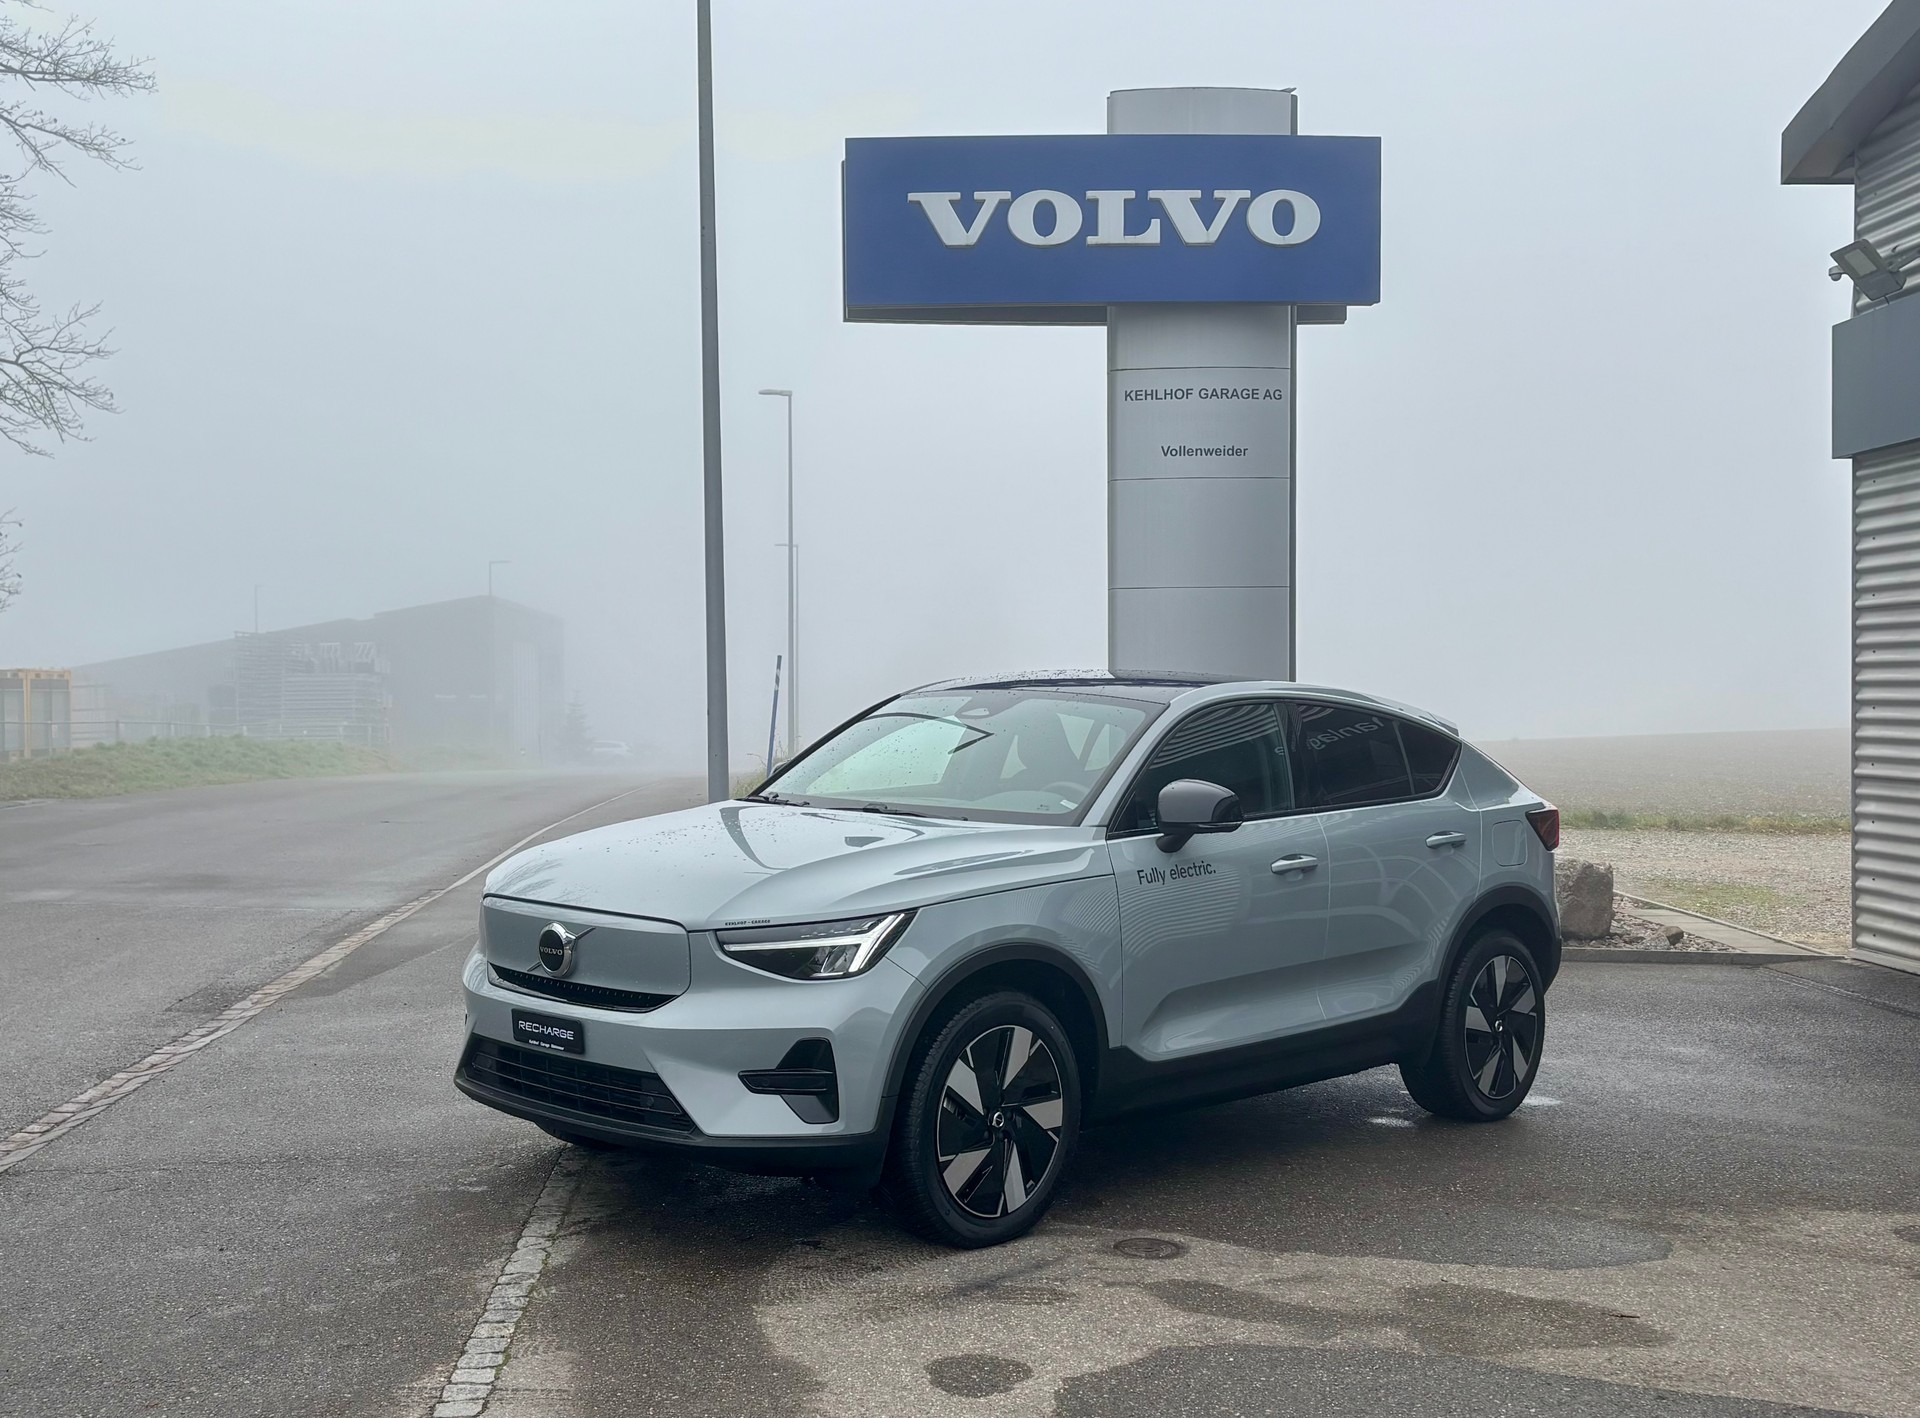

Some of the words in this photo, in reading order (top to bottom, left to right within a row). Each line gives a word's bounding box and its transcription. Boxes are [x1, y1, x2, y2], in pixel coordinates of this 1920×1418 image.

[907, 189, 1321, 247] VOLVO
[1124, 388, 1194, 401] KEHLHOF
[1198, 388, 1260, 400] GARAGE
[1263, 389, 1283, 400] AG
[1161, 445, 1249, 457] Vollenweider
[1137, 867, 1166, 885] Fully
[1169, 860, 1217, 880] electric.
[540, 946, 563, 956] VOLVO
[518, 1020, 574, 1040] RECHARGE
